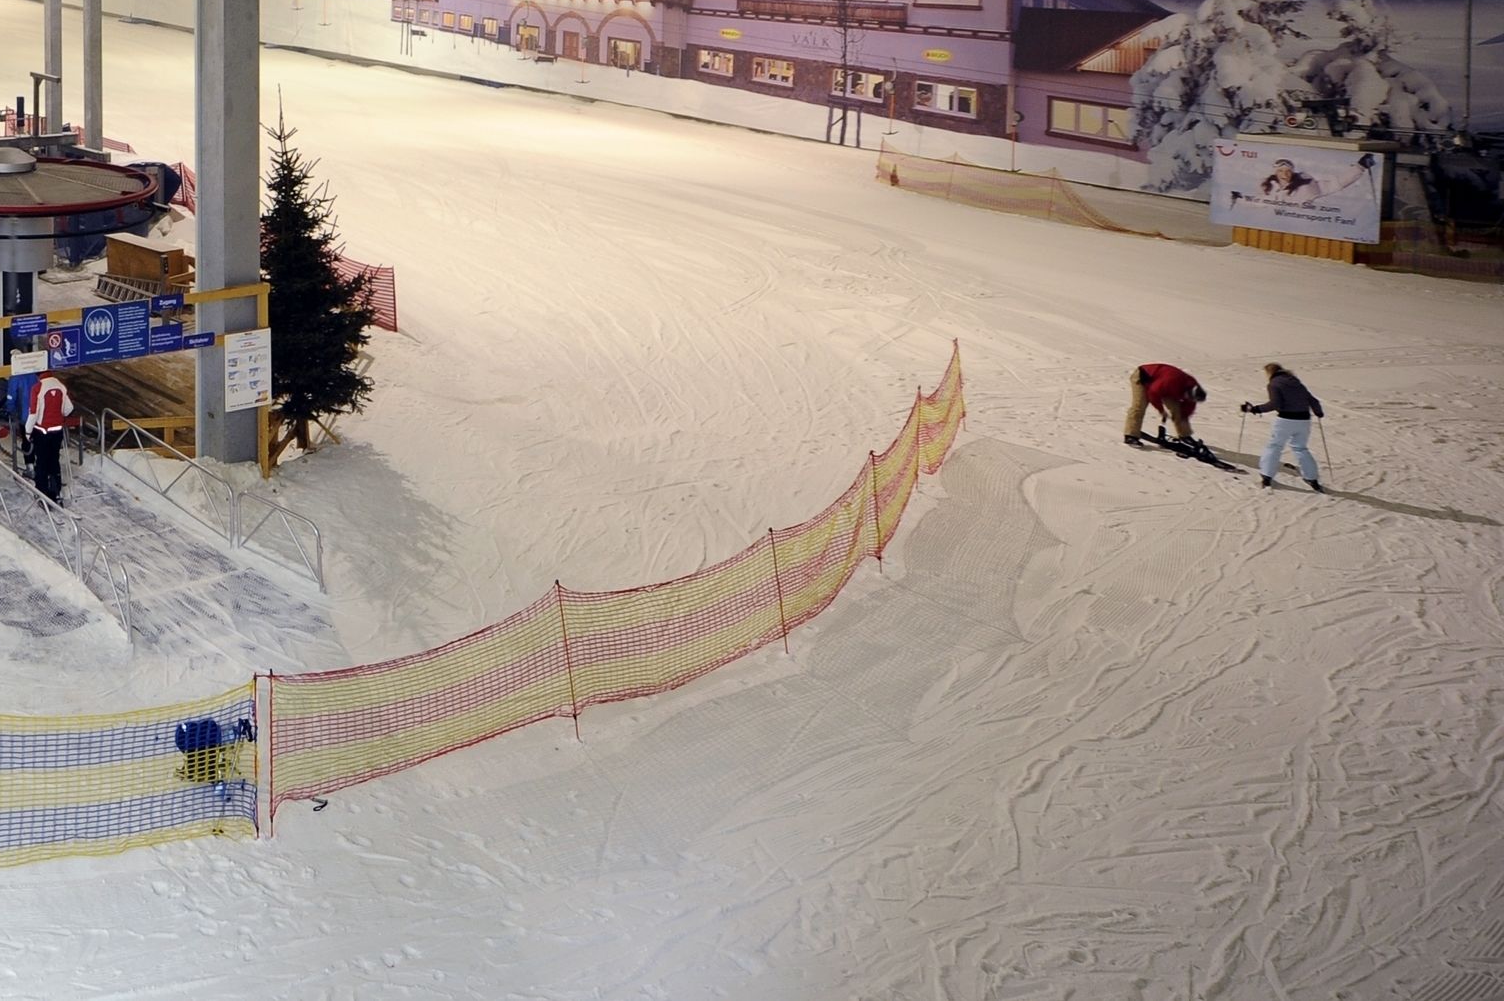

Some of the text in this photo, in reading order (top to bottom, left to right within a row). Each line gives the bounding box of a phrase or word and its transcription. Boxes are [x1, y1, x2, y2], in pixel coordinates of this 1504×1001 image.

[1241, 150, 1258, 159] TUI
[1301, 201, 1317, 210] Sie
[1319, 205, 1342, 213] zum
[1274, 208, 1332, 223] Wintersport
